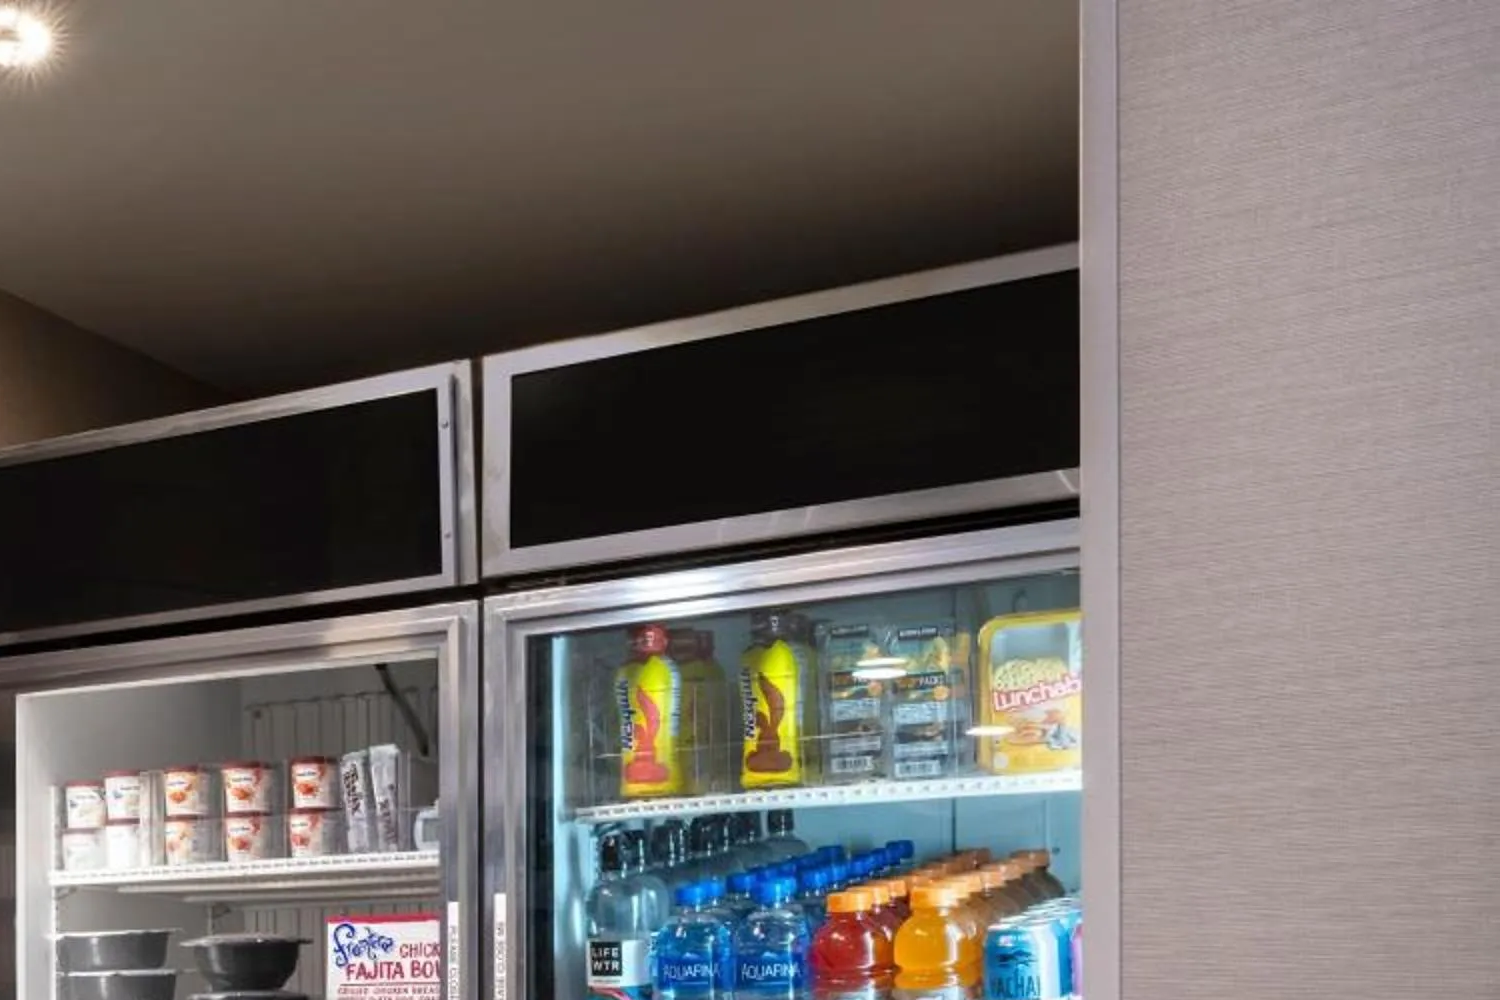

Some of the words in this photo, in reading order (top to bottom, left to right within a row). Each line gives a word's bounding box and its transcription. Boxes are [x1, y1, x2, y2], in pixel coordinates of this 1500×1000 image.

[346, 961, 404, 981] FAJITA
[663, 962, 720, 979] AQUAFINA
[741, 961, 799, 979] AQUAFINA
